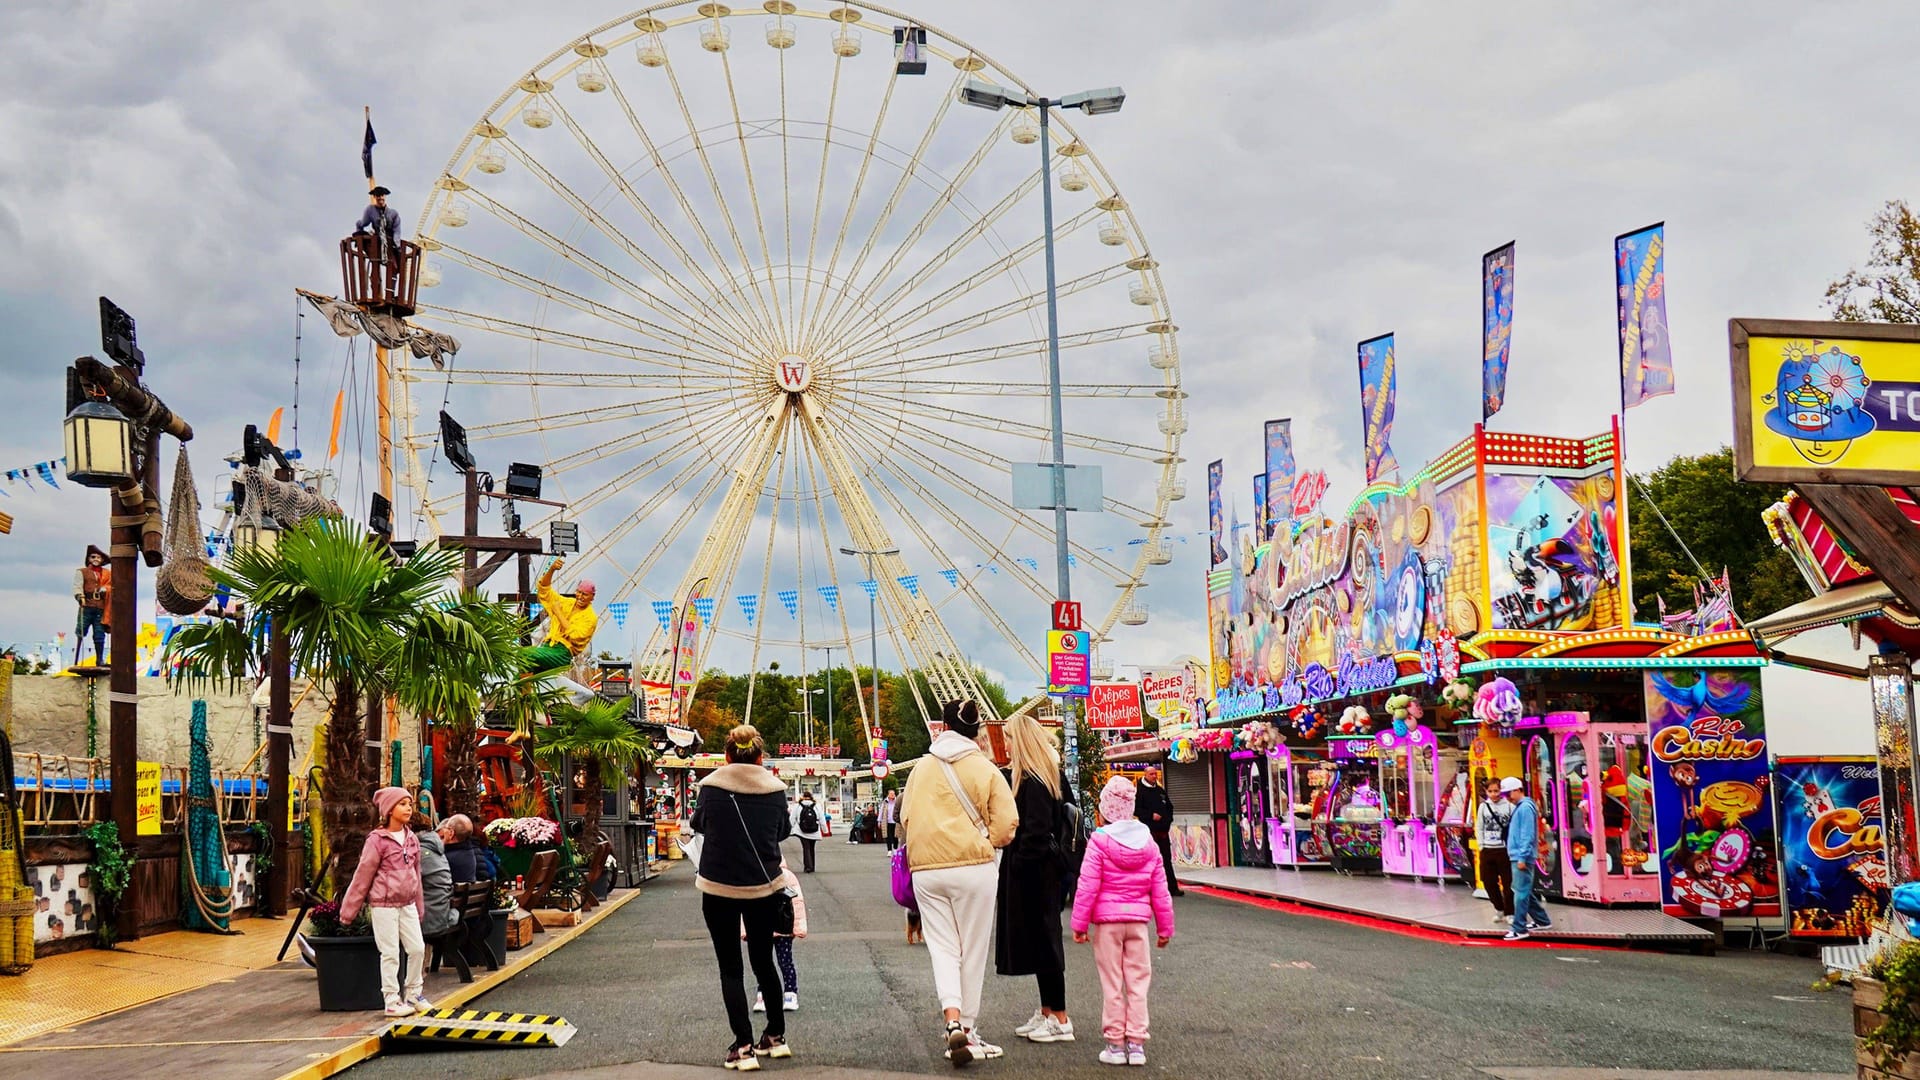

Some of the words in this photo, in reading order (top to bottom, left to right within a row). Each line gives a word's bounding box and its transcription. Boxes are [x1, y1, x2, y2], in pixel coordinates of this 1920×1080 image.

[779, 361, 807, 385] W
[1059, 603, 1079, 628] 41
[1304, 661, 1334, 701] Rio
[1336, 652, 1398, 698] Casino
[1092, 686, 1130, 706] Crêpes
[1146, 691, 1180, 701] nutella
[1088, 704, 1139, 726] Poffertjes
[872, 728, 883, 738] 42
[1691, 717, 1744, 739] Rio
[1652, 725, 1765, 761] Casino
